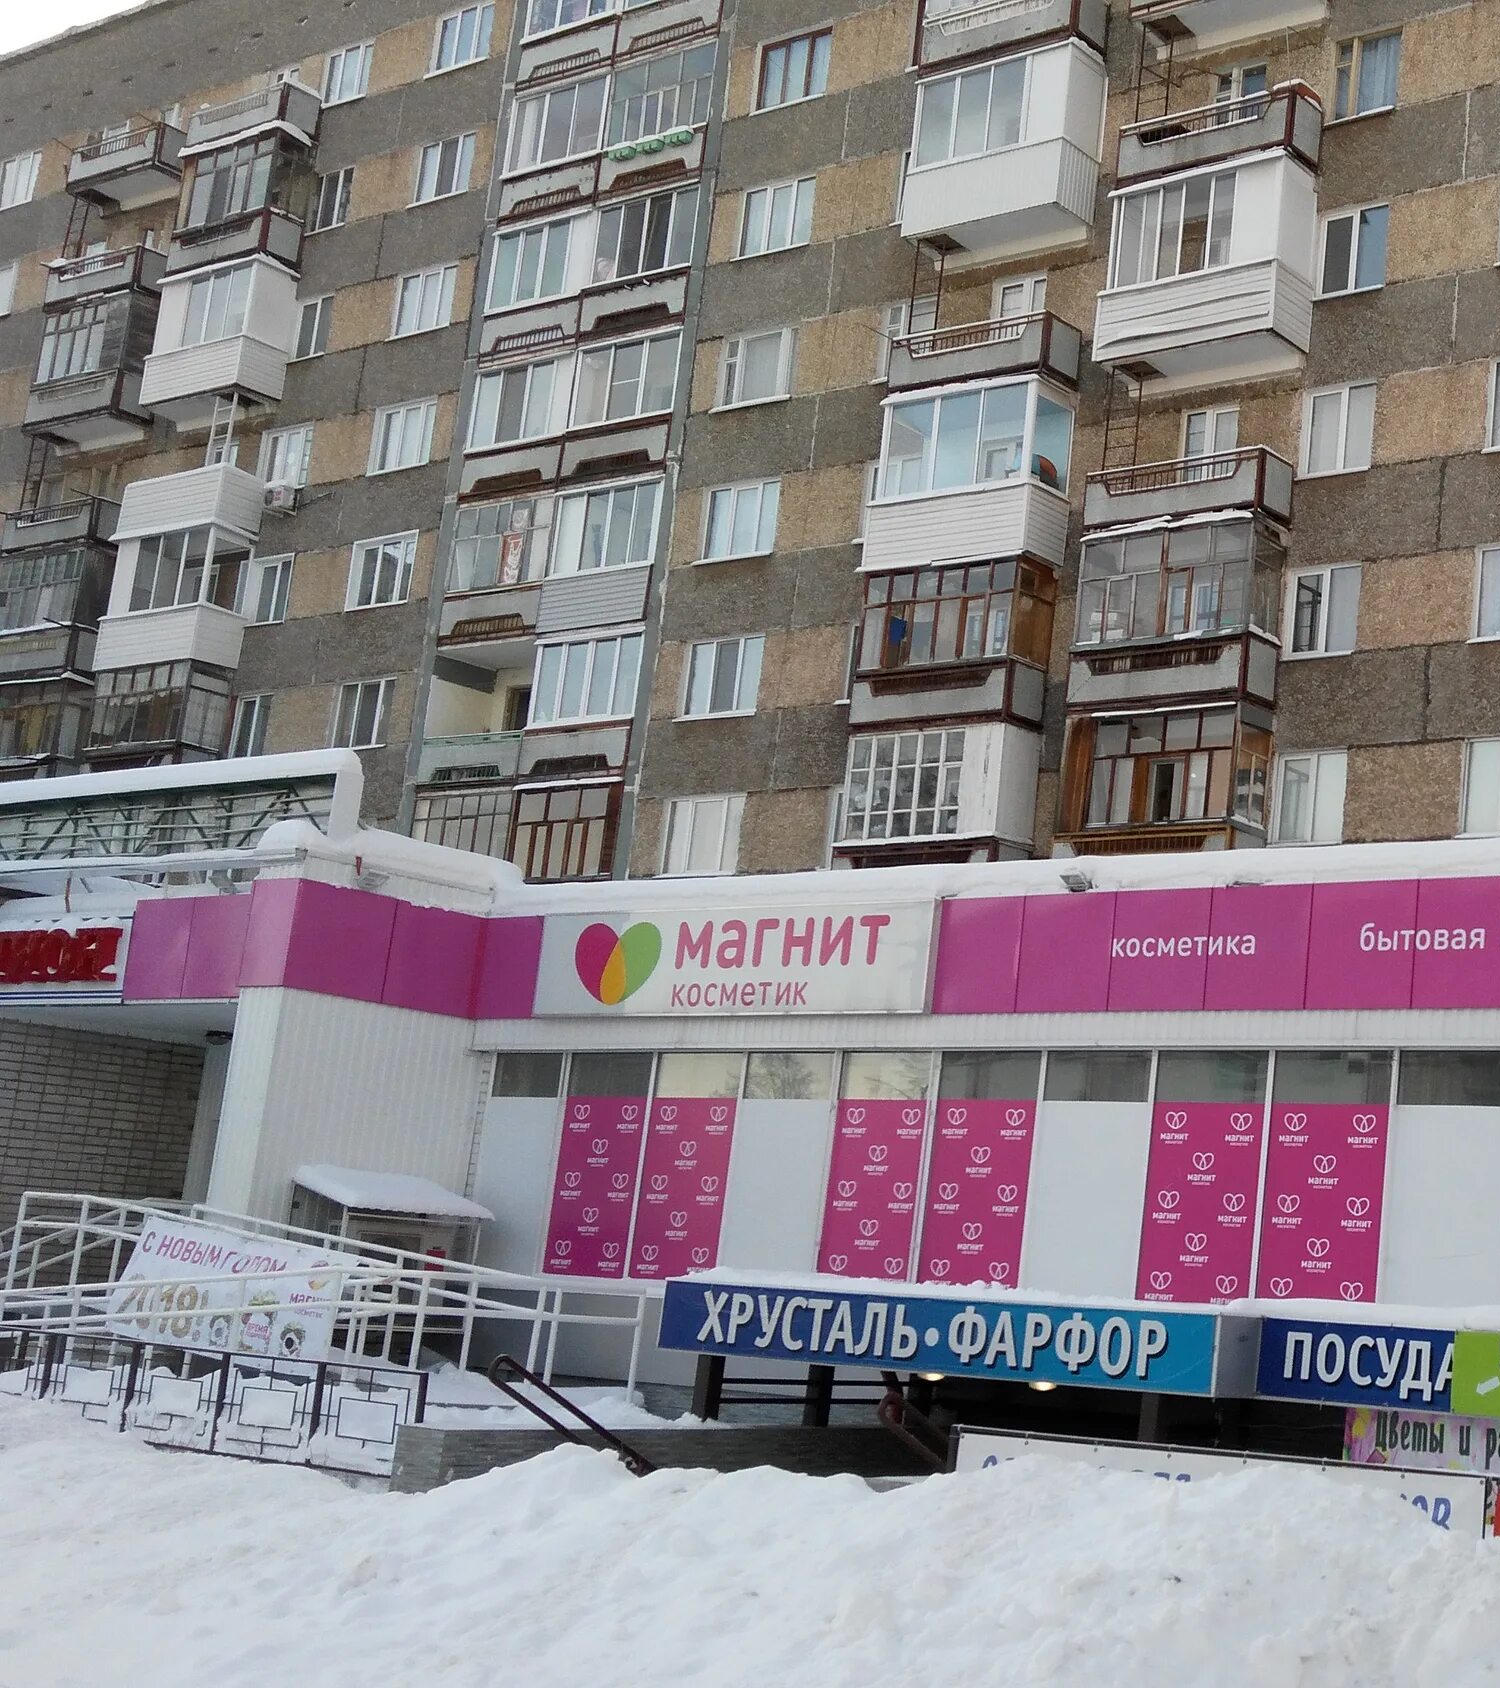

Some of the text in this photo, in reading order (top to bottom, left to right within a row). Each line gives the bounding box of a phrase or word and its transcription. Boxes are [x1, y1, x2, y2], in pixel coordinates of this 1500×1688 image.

[674, 913, 891, 970] магнит
[1111, 934, 1256, 958] косметика
[1359, 922, 1487, 951] бытовая
[671, 981, 808, 1008] косметик
[156, 1235, 223, 1269] НОВЫМ
[697, 1290, 1168, 1379] ХРУСТАЛЬ ФАРФОР
[1459, 1425, 1471, 1456] и
